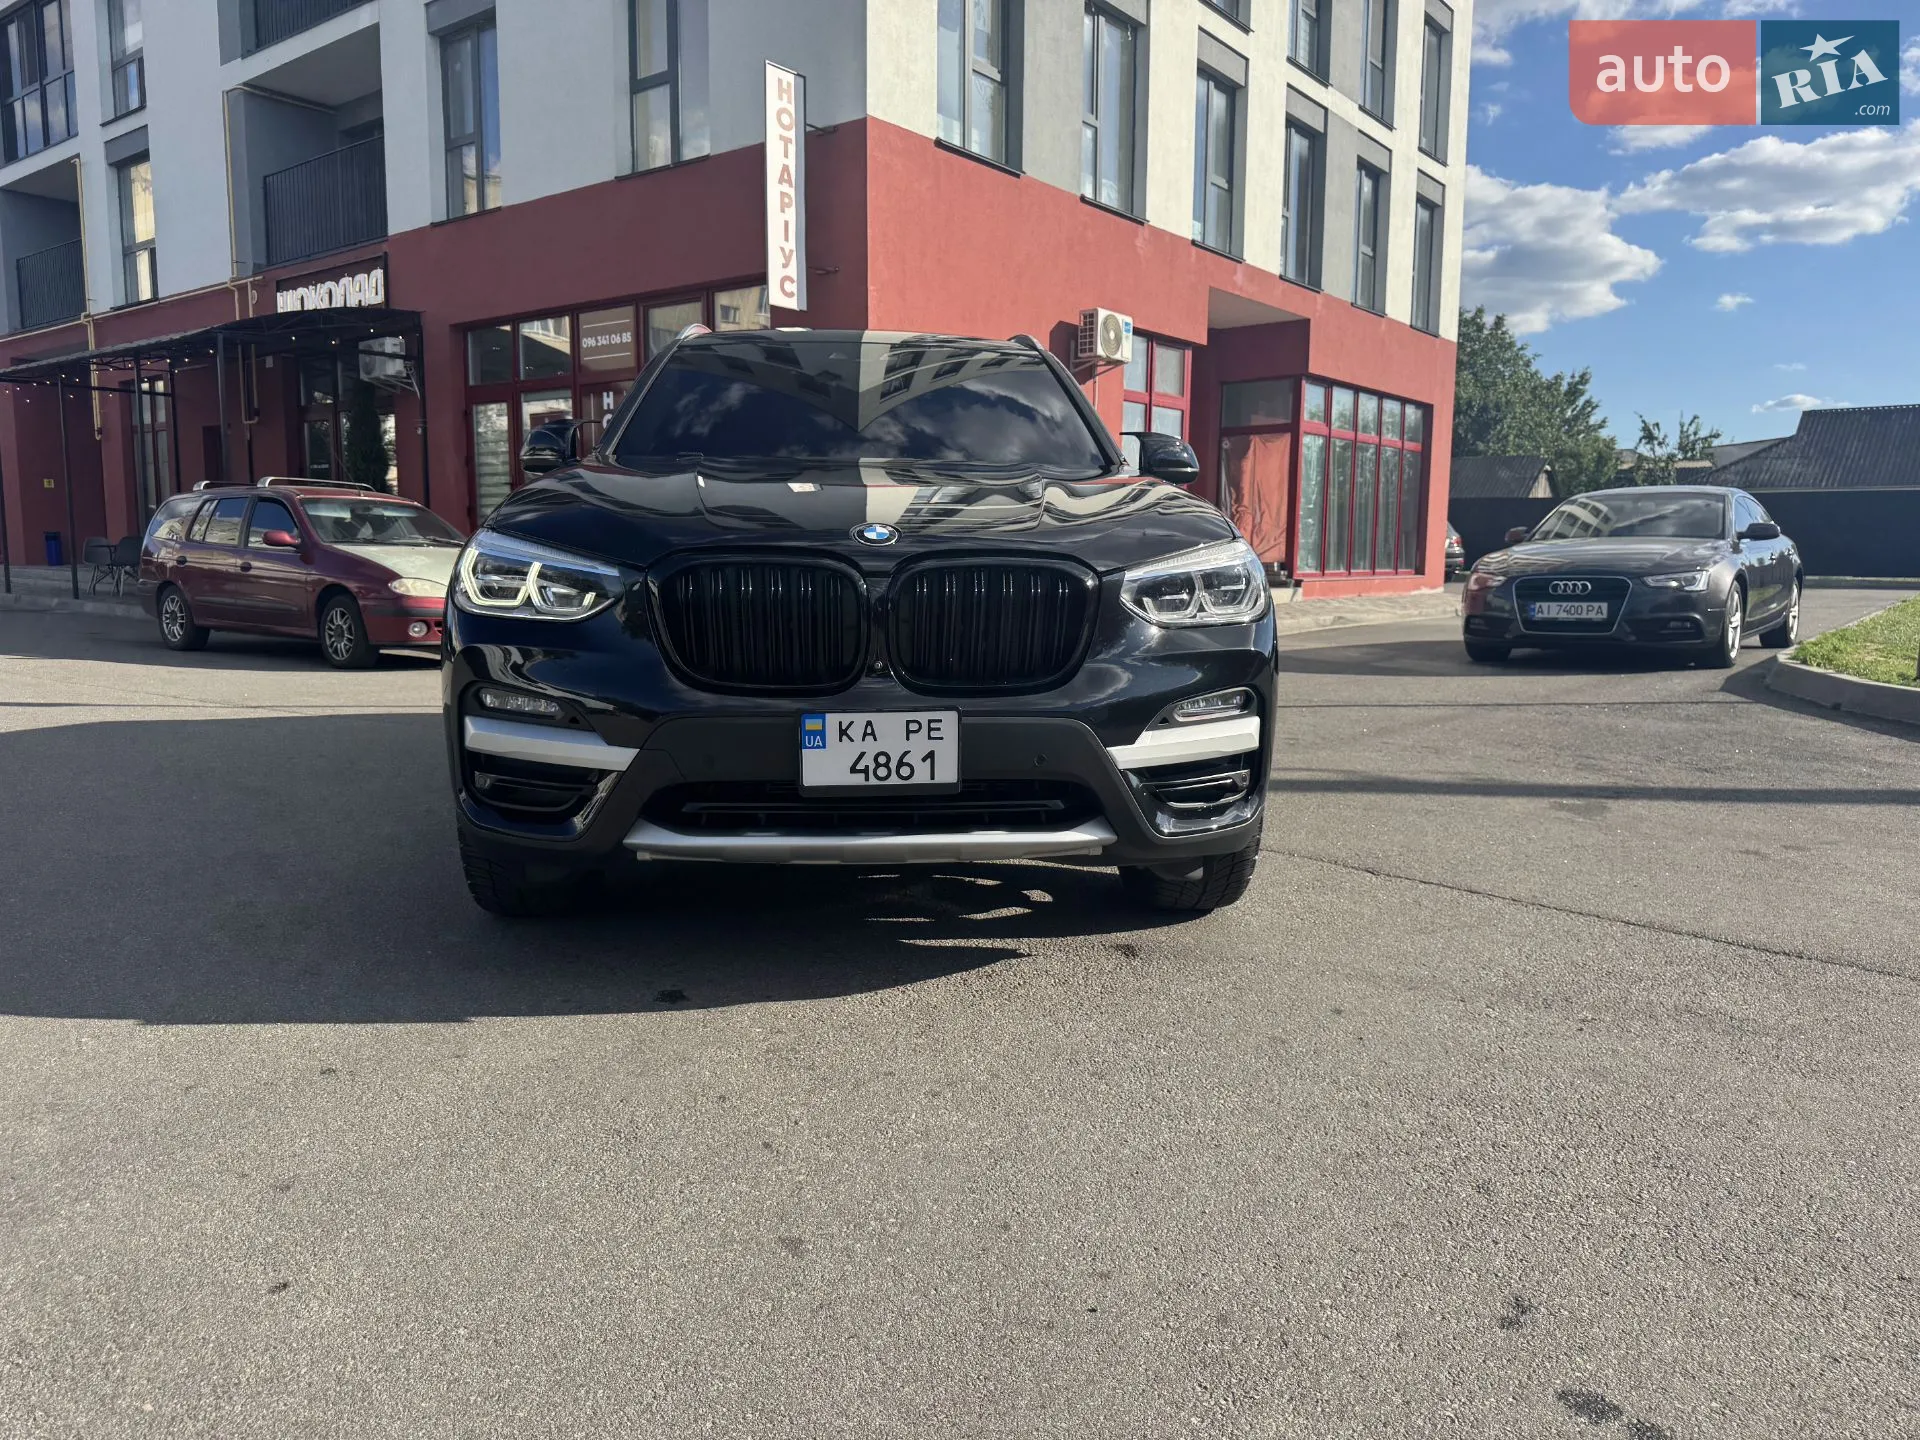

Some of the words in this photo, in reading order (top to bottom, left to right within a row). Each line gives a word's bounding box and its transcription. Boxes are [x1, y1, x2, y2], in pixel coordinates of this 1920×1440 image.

[775, 76, 797, 299] НОТАРІУС
[276, 267, 385, 313] ШОКОЛАД
[582, 336, 596, 348] 096
[610, 333, 621, 345] 06
[622, 331, 632, 343] 85
[1536, 604, 1550, 616] AI
[1555, 604, 1584, 616] 7400
[1586, 604, 1604, 616] PA
[804, 735, 823, 747] UA
[838, 719, 878, 743] KA
[905, 718, 944, 742] PE
[849, 749, 936, 782] 4861
